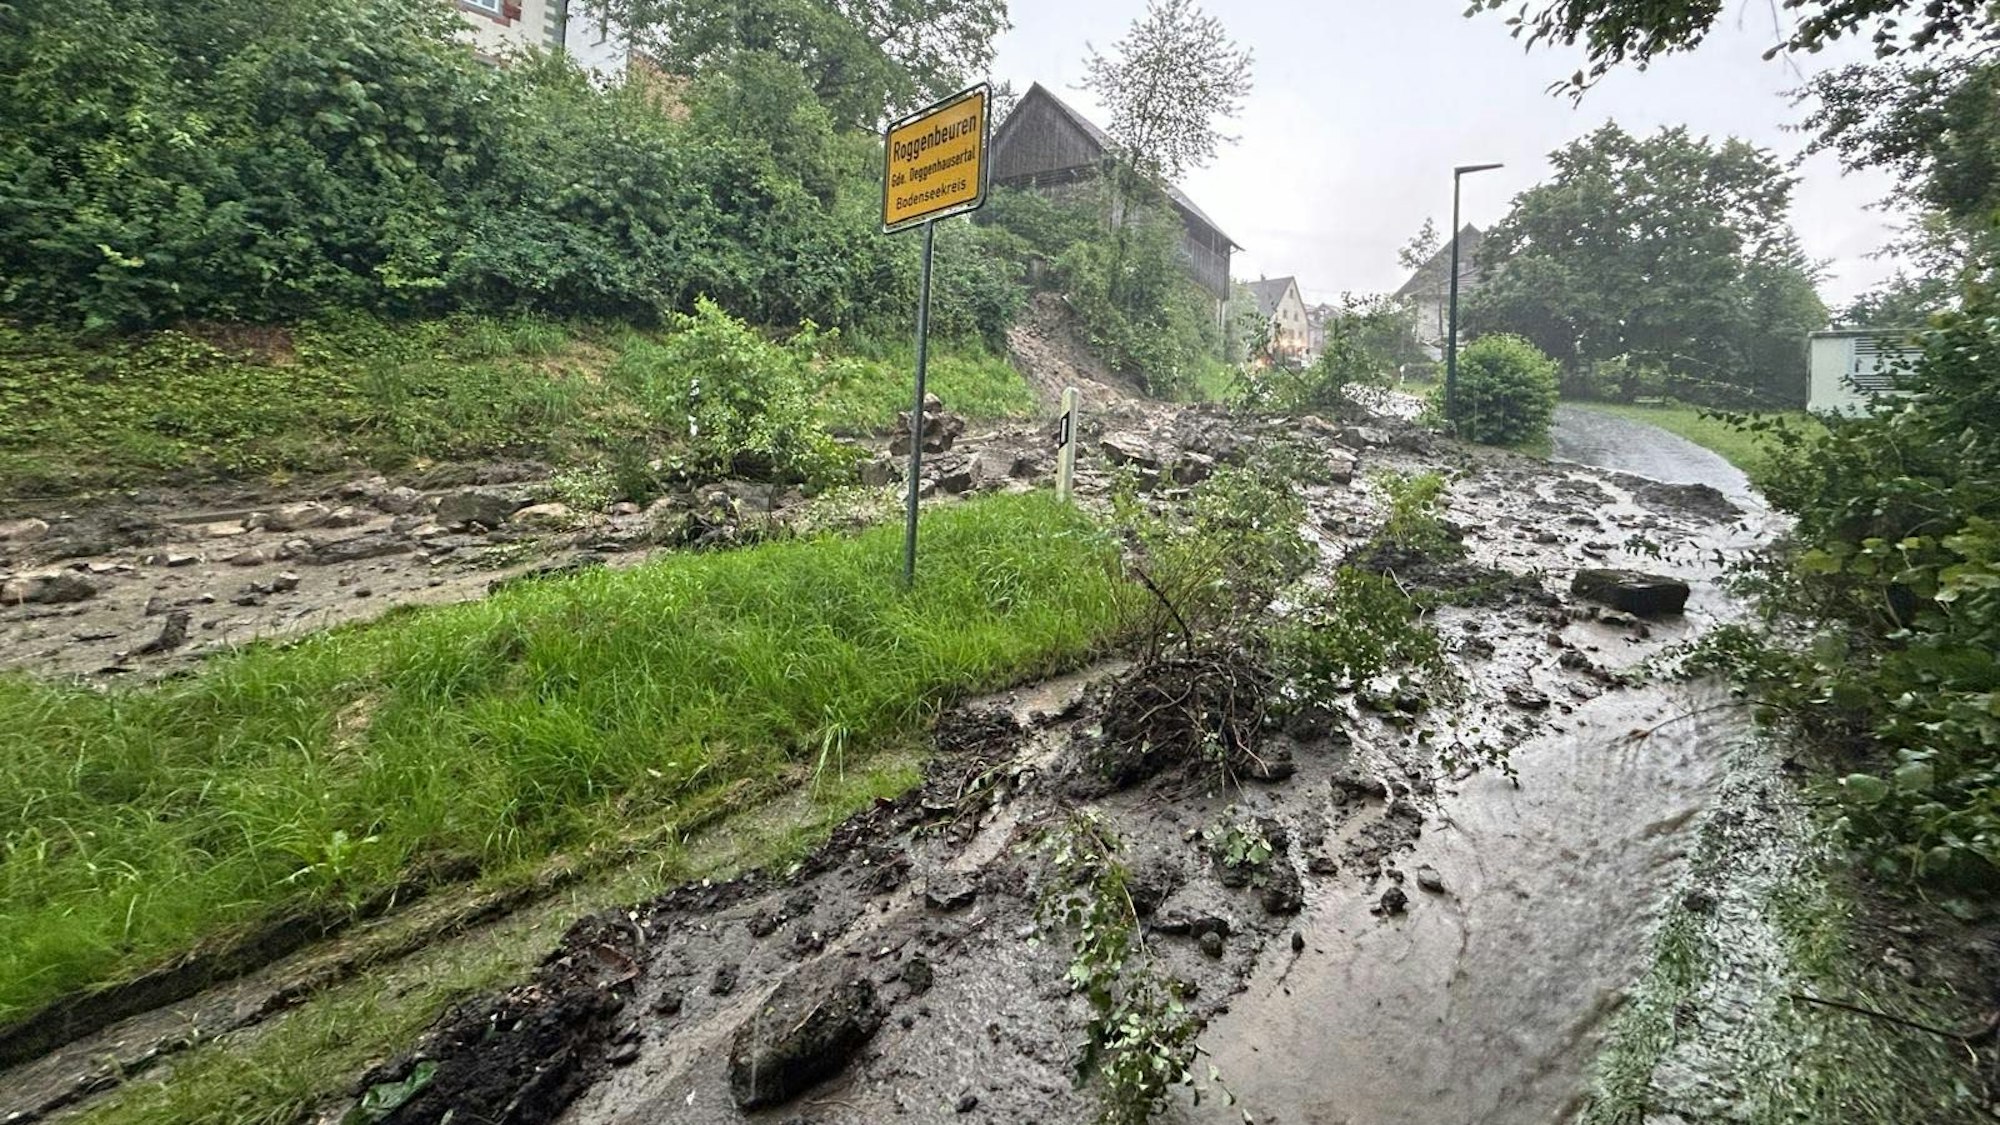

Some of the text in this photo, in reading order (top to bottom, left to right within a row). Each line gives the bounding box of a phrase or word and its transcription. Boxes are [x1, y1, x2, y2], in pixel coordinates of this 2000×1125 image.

[893, 115, 977, 162] Roggenbeuren
[891, 146, 976, 188] Gde. Deggenhausertal
[896, 178, 967, 210] Bodenseekreis
